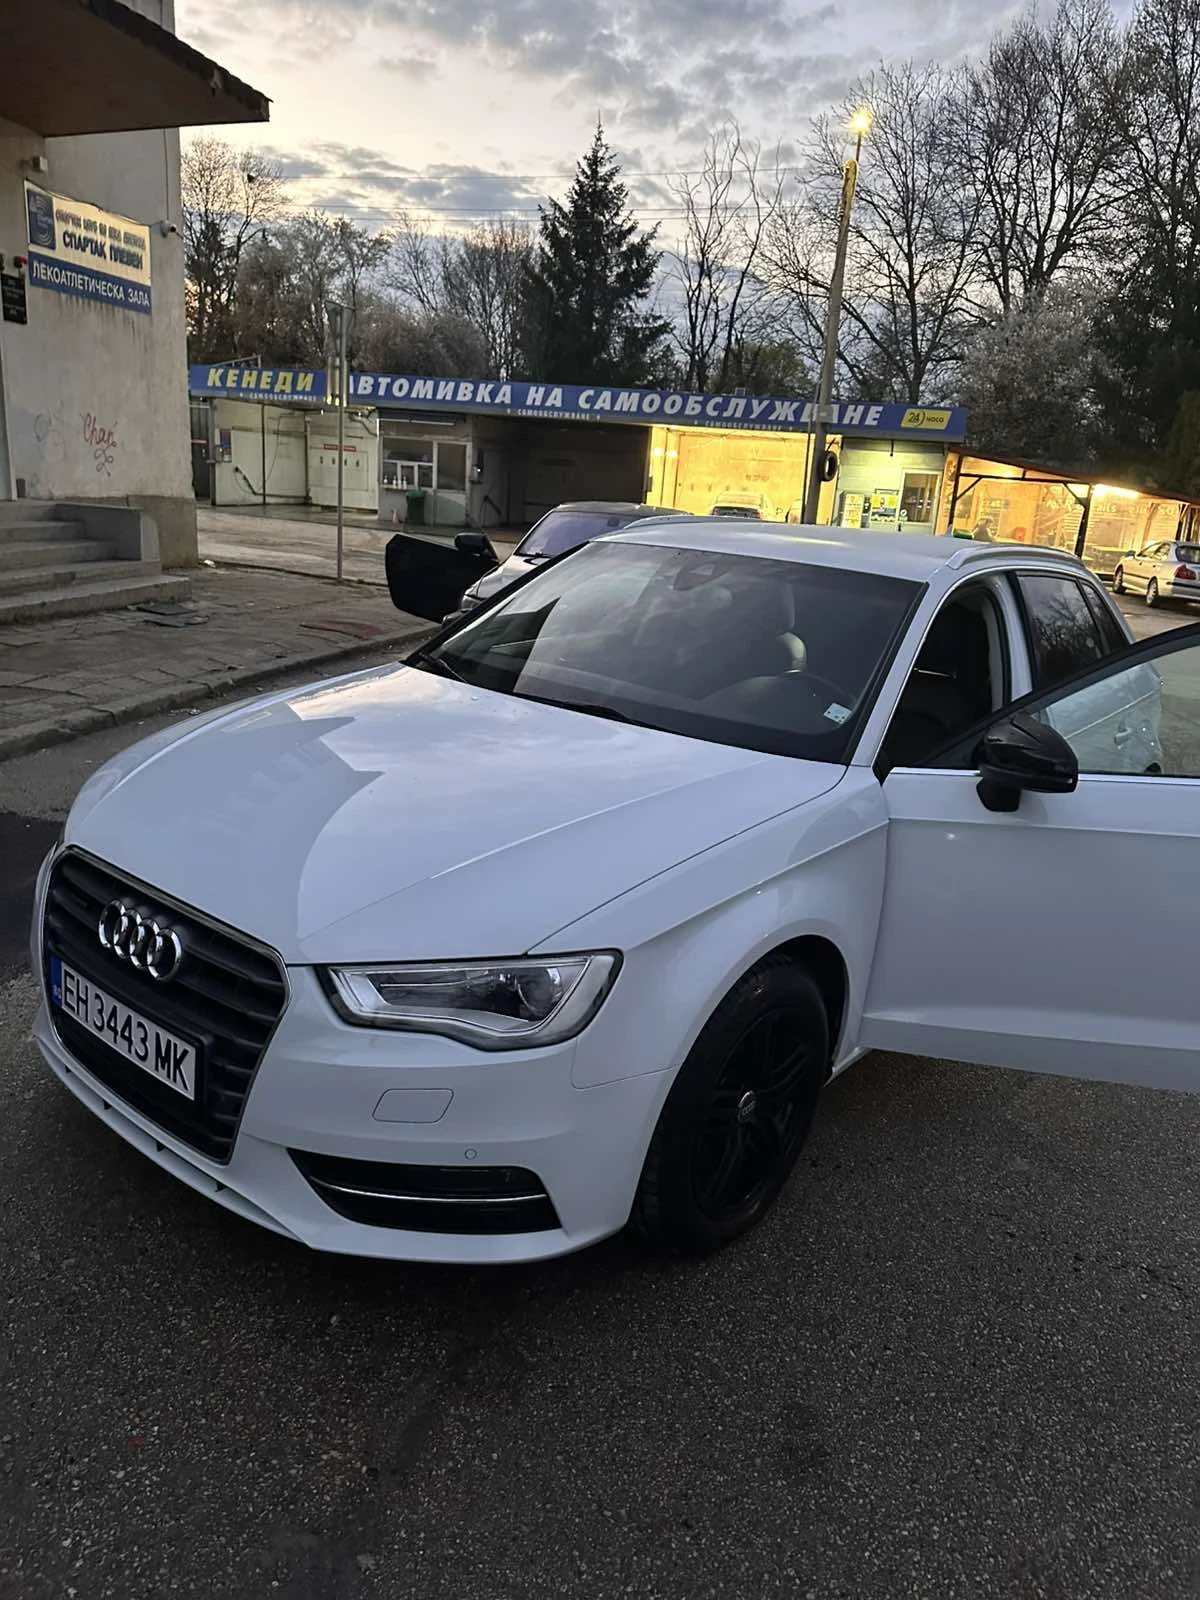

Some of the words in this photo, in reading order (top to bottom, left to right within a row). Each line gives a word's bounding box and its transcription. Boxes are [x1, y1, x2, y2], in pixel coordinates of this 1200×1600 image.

[63, 230, 106, 260] СПАРТАК
[33, 260, 125, 300] ЛЕКОАТЛЕТИЧЕСКА
[127, 288, 150, 306] ЗАЛА
[207, 367, 314, 393] КЕНЕДИ
[349, 375, 512, 404] ВТОМИВКА
[526, 386, 562, 407] НА
[63, 969, 89, 1024] EH
[93, 993, 150, 1062] 3443
[154, 1031, 191, 1092] MK
